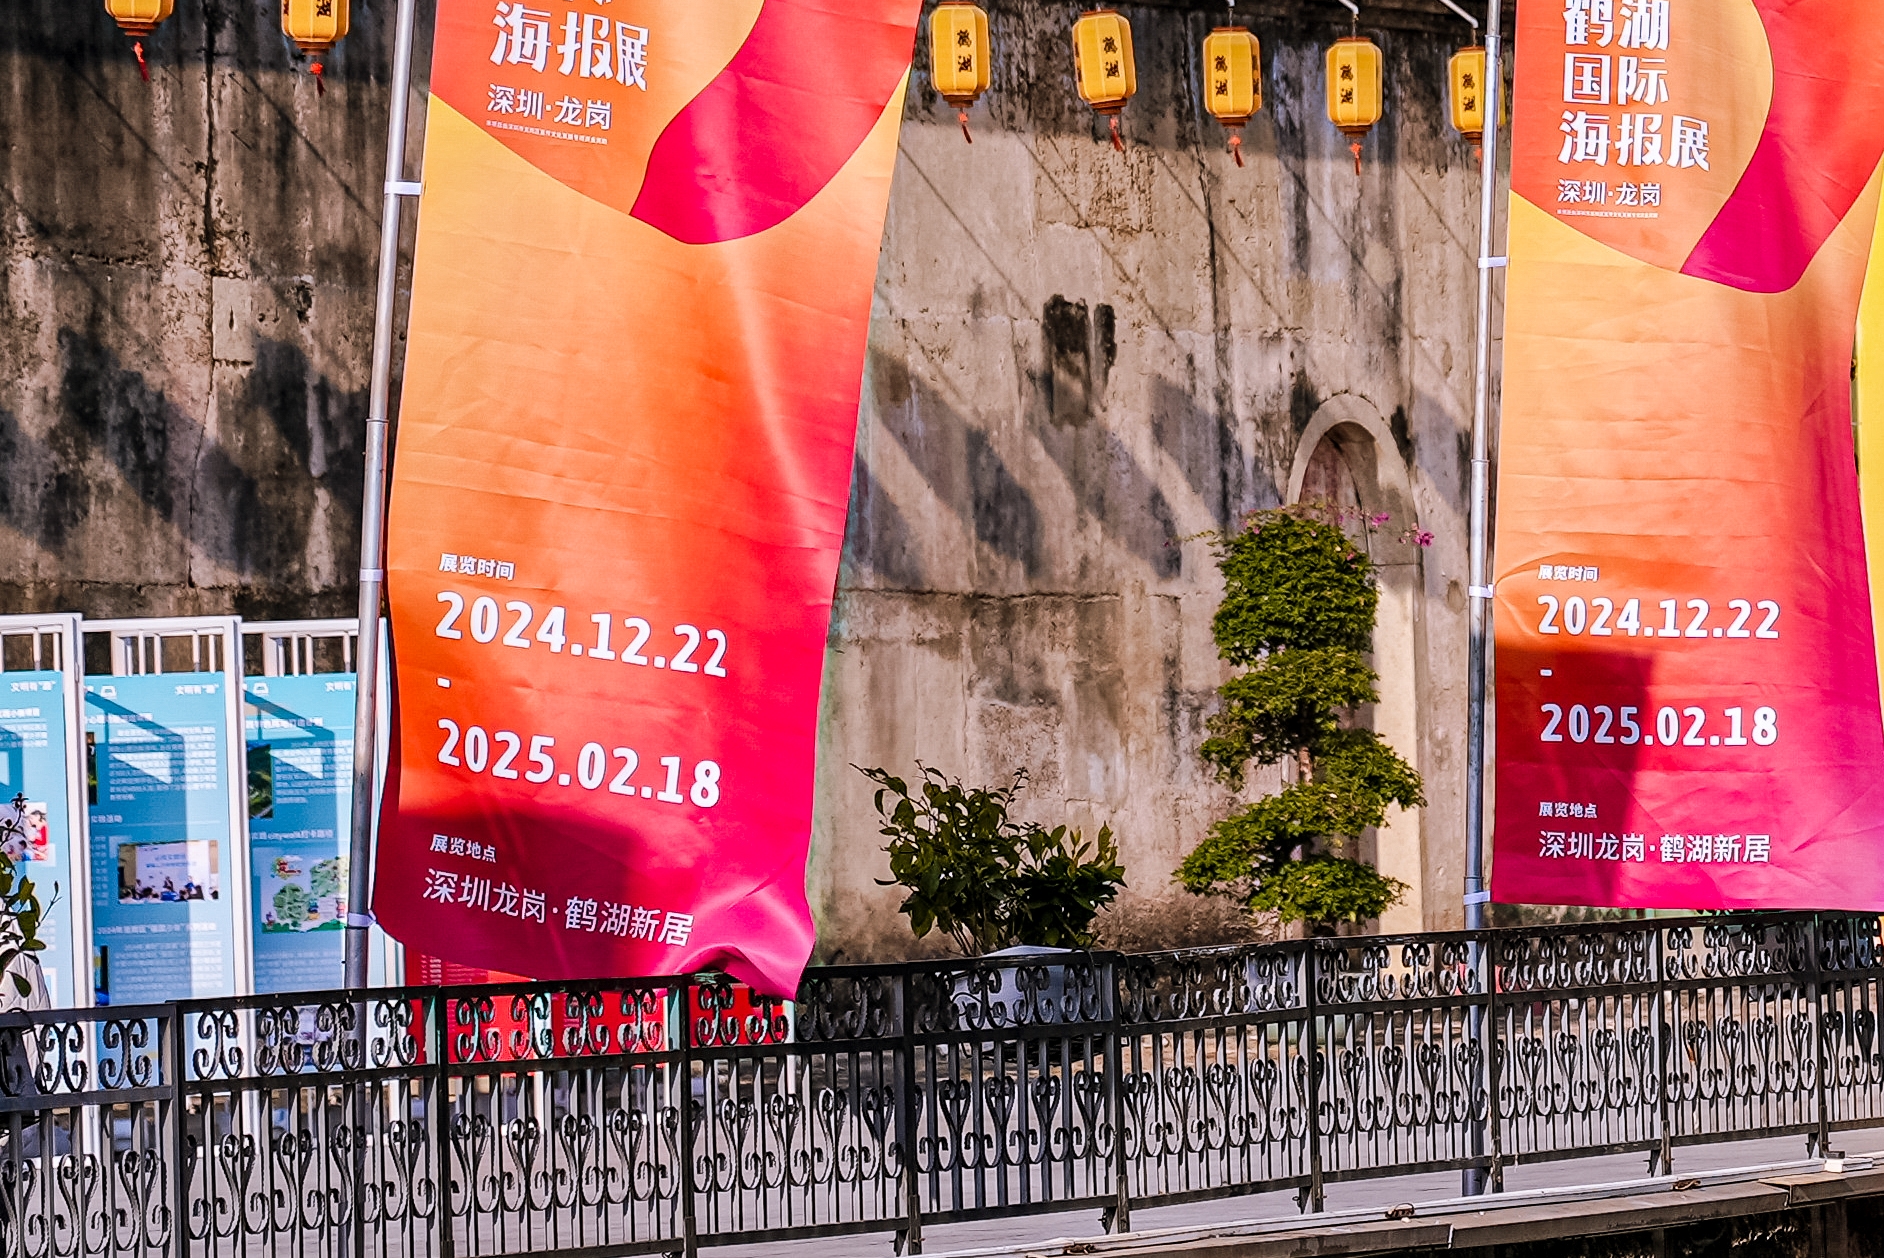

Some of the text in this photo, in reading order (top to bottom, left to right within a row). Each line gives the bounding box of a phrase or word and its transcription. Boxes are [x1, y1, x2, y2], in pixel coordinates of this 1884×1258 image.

[489, 3, 649, 91] 海报展
[1563, 53, 1669, 106] 国际
[487, 84, 612, 131] 深圳·龙岗
[1558, 110, 1711, 172] 海报展
[1557, 179, 1662, 207] 深圳·龙岗
[439, 553, 515, 580] 展览时间
[1537, 564, 1600, 582] 展览时间
[434, 590, 728, 679] 2024.12.22
[1537, 595, 1781, 639] 2024.12.22
[1540, 703, 1778, 746] 2025.02.18
[437, 718, 721, 809] 2025.02.18
[1538, 802, 1598, 818] 展览地点
[430, 833, 497, 863] 展览地点
[1538, 830, 1770, 863] 深圳龙岗·鹤湖新居
[422, 868, 694, 947] 深圳龙岗·鹤湖新居
